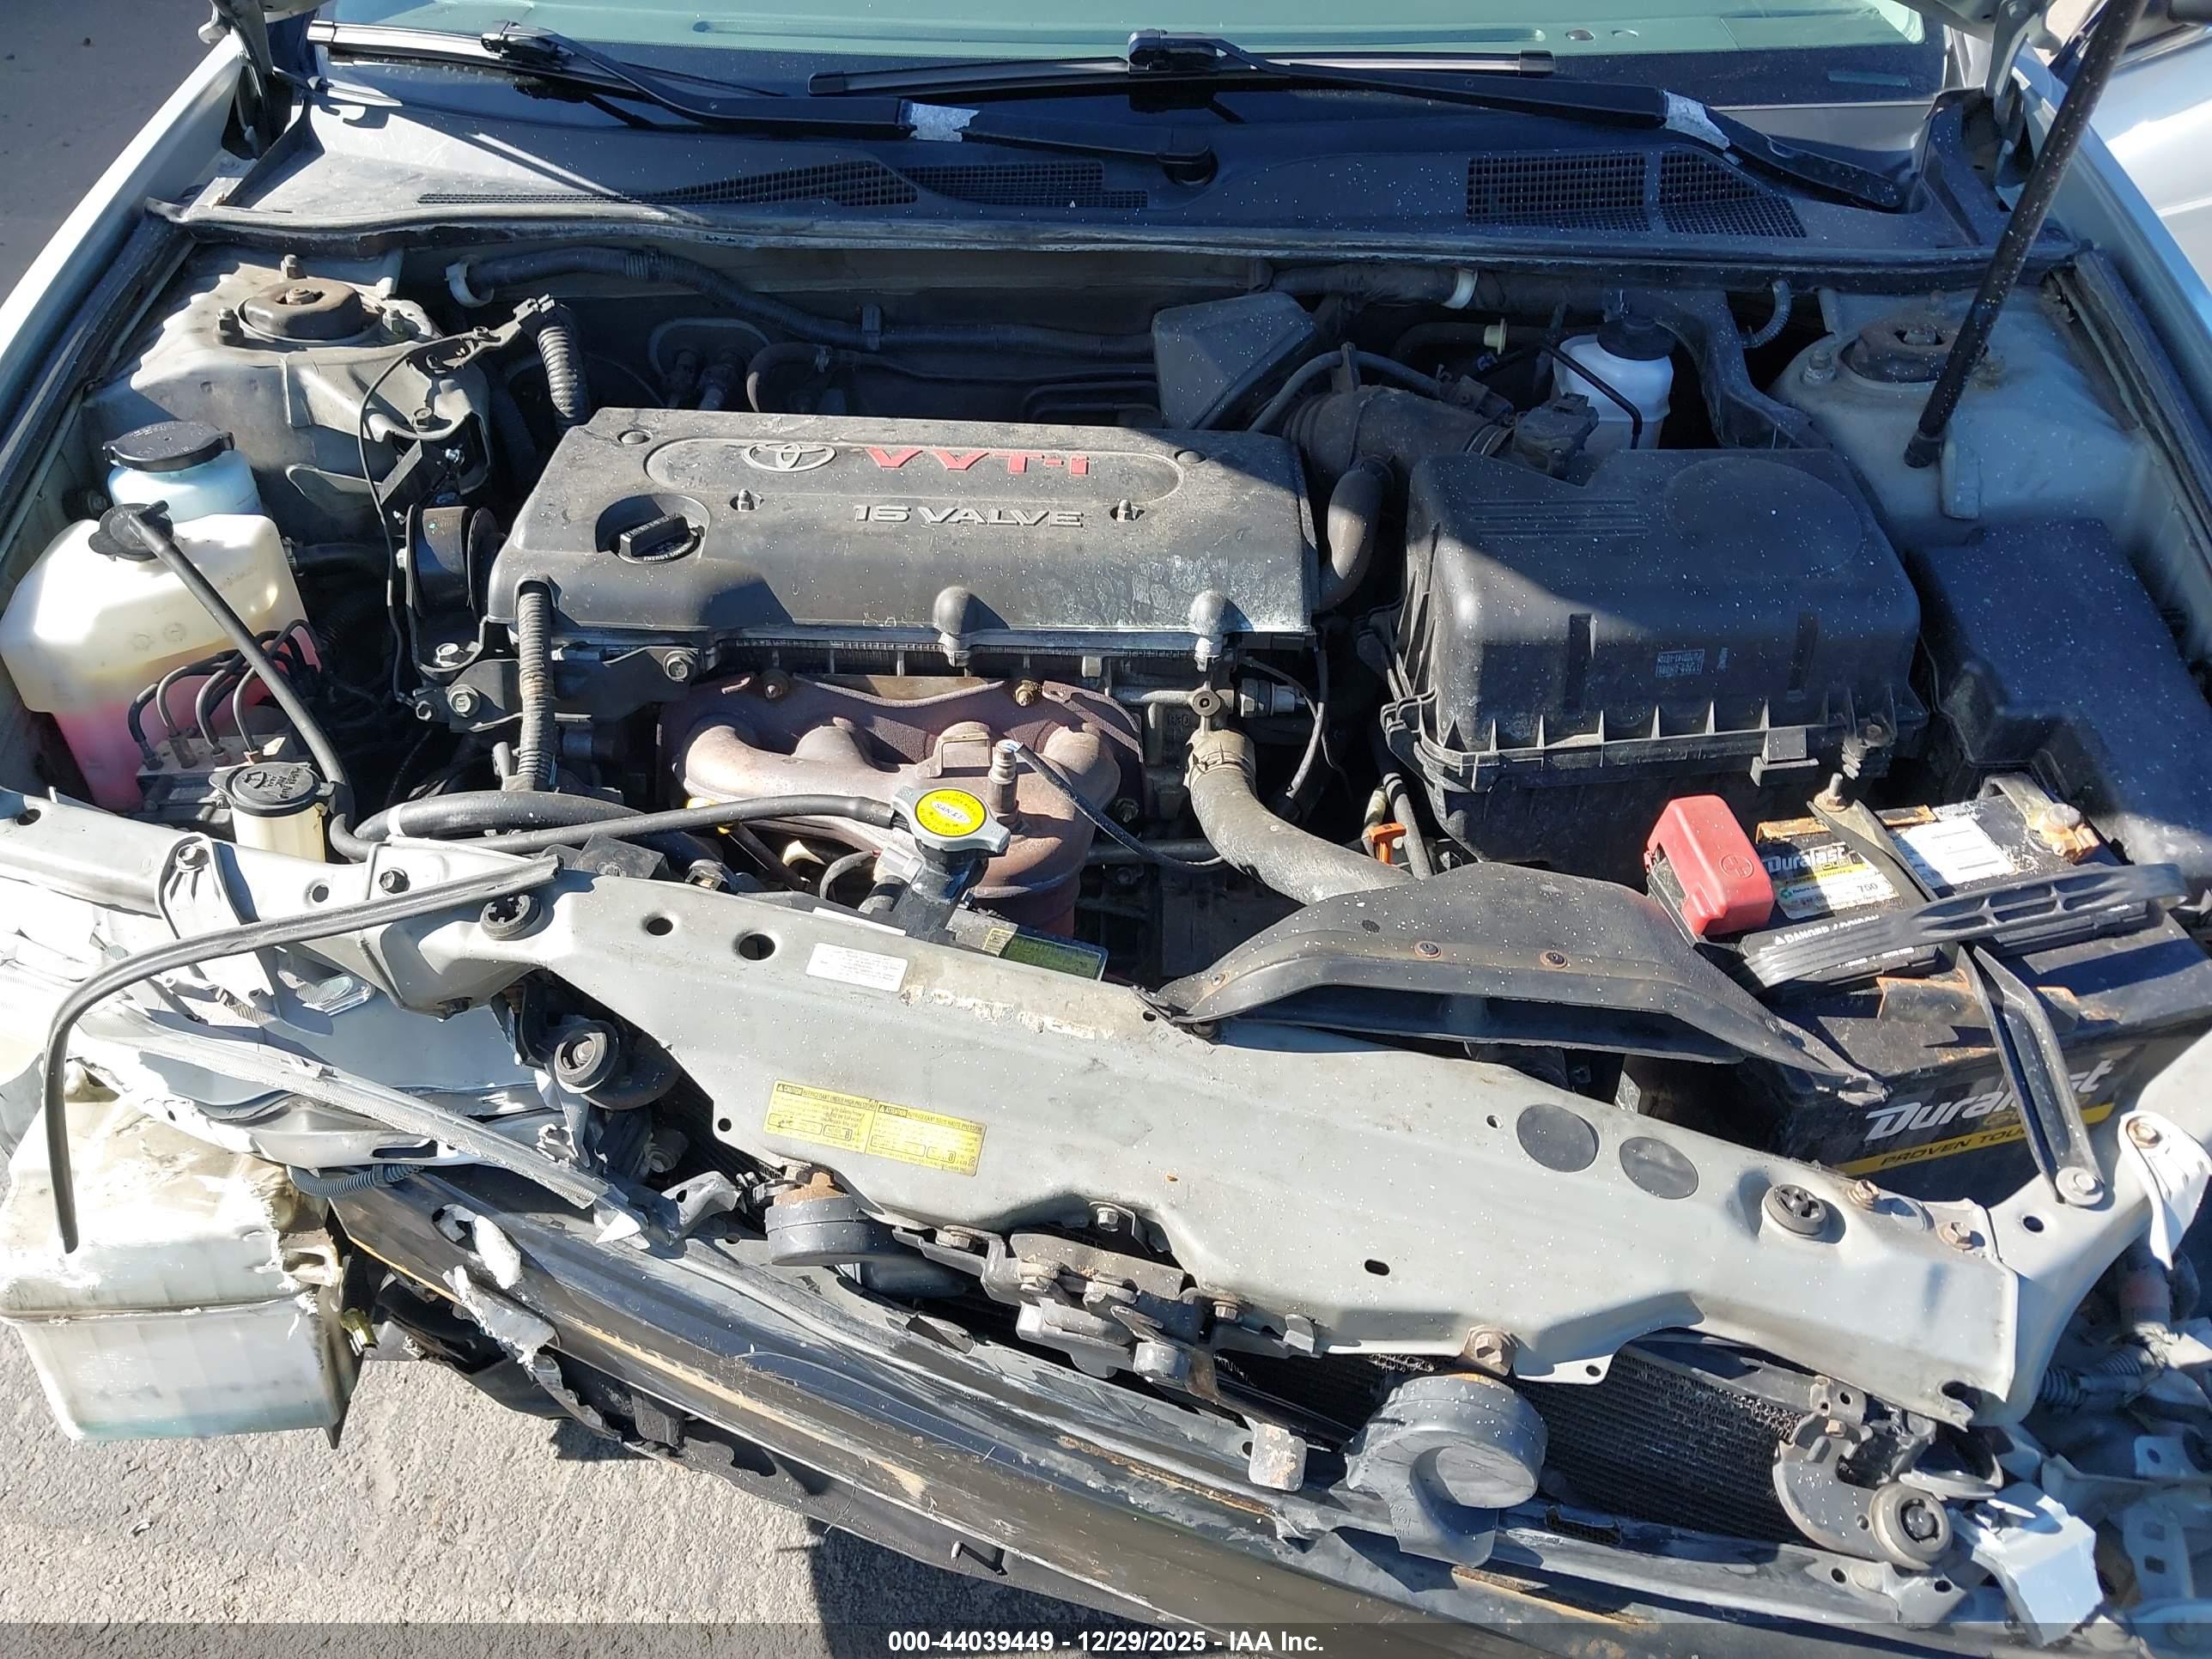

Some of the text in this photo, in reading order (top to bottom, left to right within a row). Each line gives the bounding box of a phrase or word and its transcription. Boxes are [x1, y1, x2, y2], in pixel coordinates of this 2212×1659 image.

[854, 505, 1084, 528] 16 VALVE
[1762, 842, 1847, 874] Duralast
[1881, 1139, 1972, 1166] PROVEN
